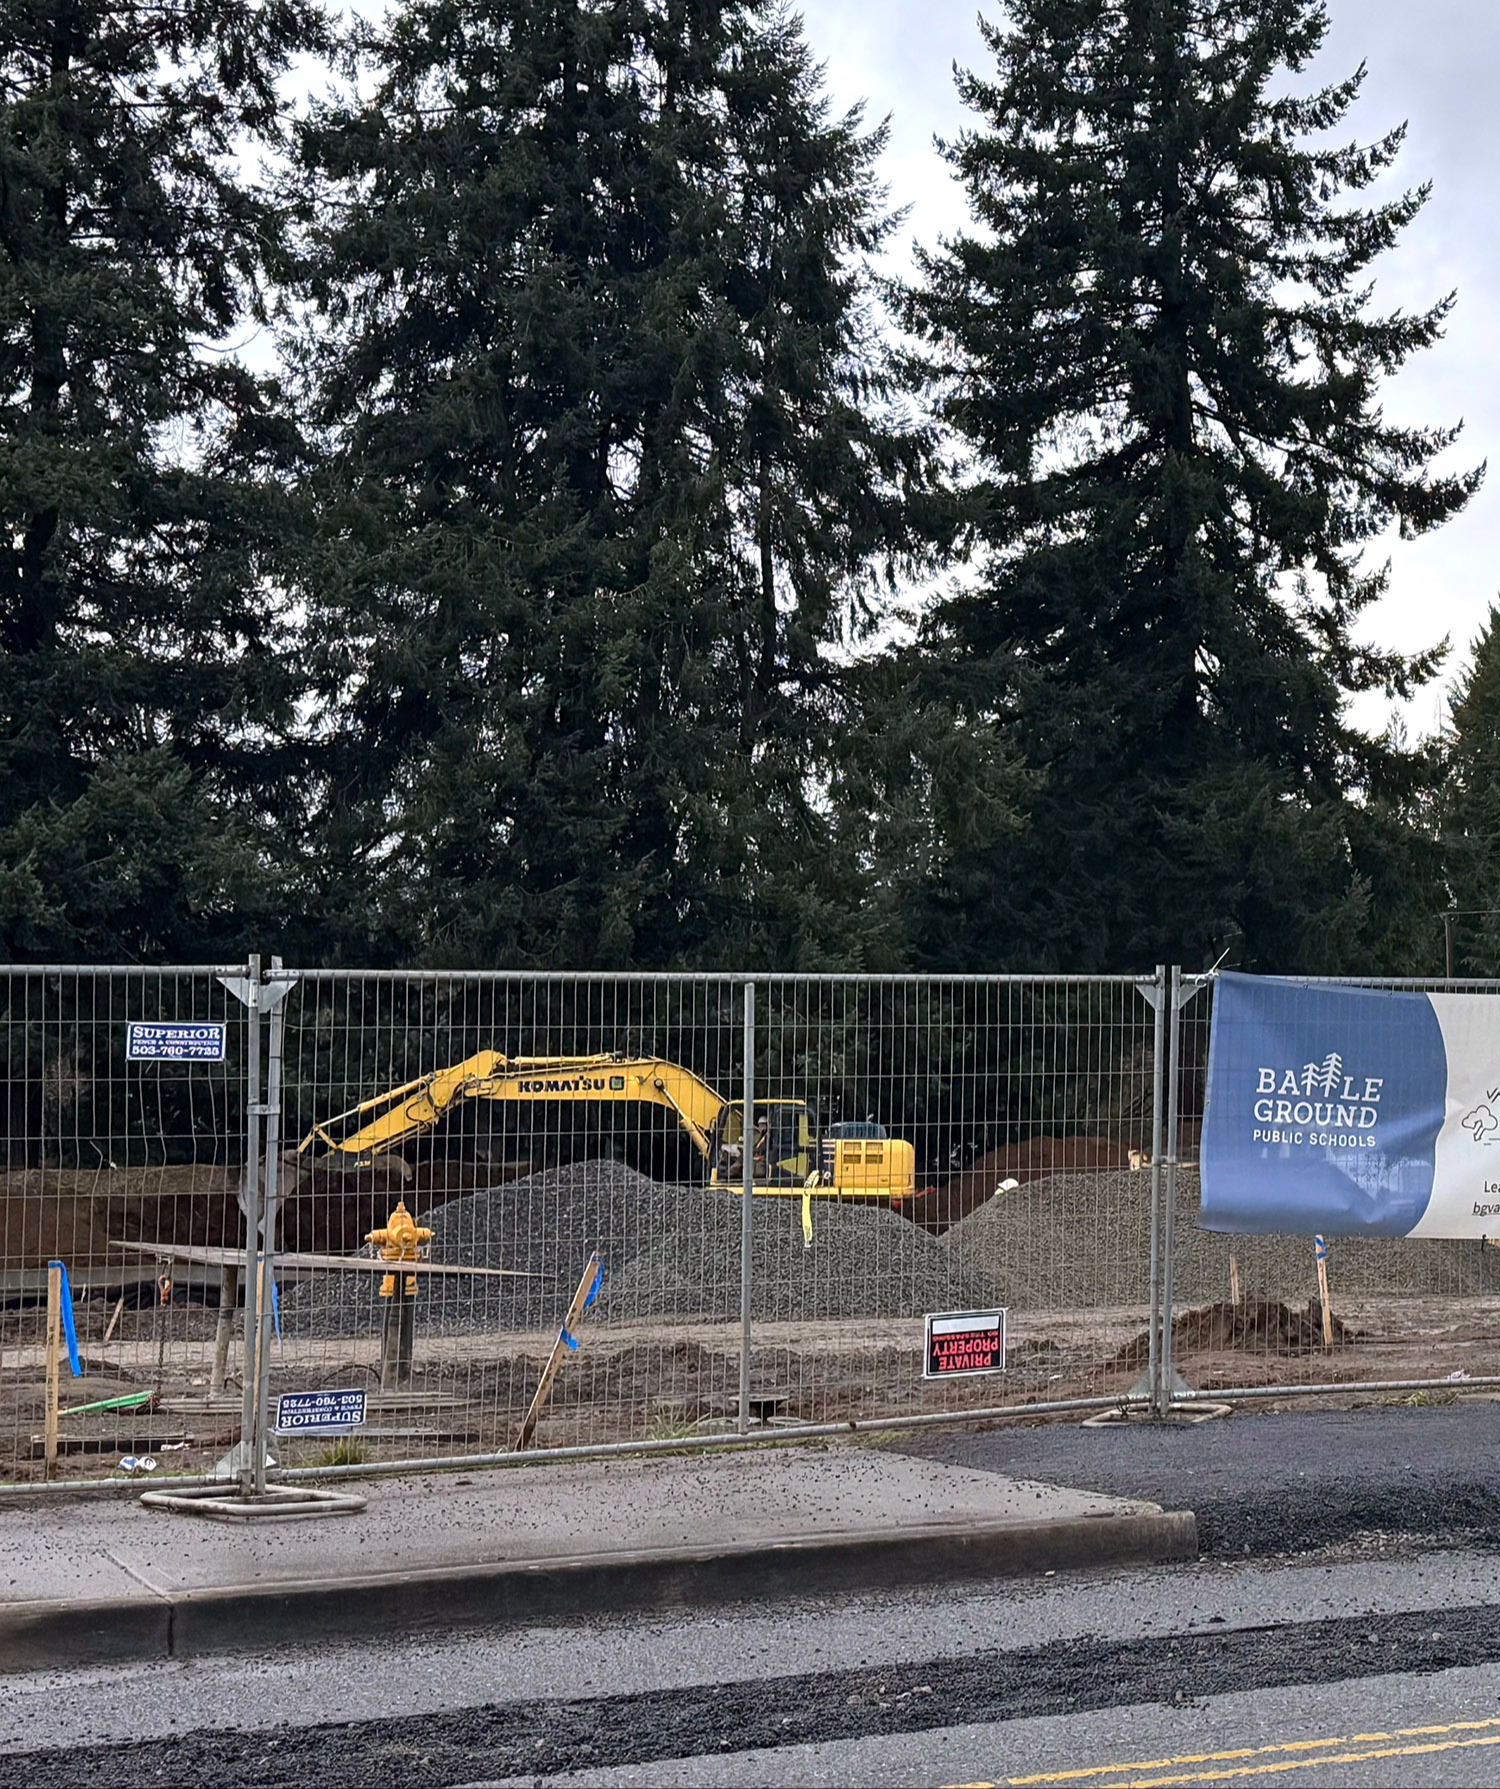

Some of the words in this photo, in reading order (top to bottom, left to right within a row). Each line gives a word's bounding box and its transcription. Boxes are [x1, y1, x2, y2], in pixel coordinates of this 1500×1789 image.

[133, 1026, 220, 1040] SUPERIOR
[518, 1075, 605, 1093] KOMATSU
[1254, 1098, 1378, 1128] GROUND
[1253, 1129, 1303, 1144] PUBLIC
[1309, 1132, 1376, 1147] SCHOOLS
[932, 1337, 999, 1357] PROPERTY
[938, 1352, 992, 1371] PRIVATE
[281, 1411, 362, 1427] SUPERIOR
